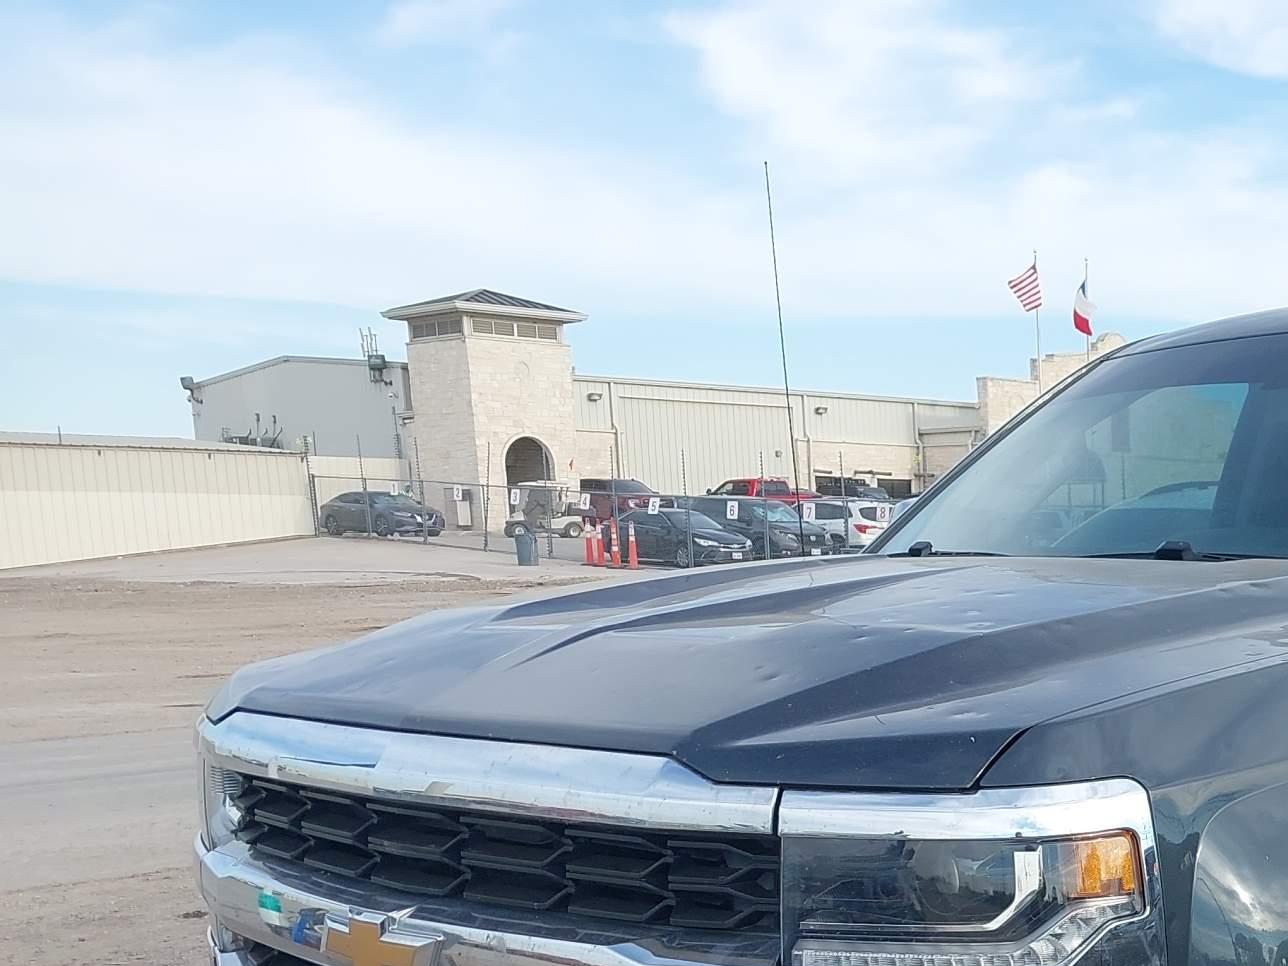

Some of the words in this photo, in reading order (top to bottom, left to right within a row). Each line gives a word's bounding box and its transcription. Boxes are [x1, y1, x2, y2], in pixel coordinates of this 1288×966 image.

[455, 487, 460, 498] 2
[512, 491, 518, 502] 3
[581, 496, 587, 506] 4
[651, 501, 657, 512] 5
[729, 505, 735, 516] 6
[806, 506, 812, 519] 7
[880, 506, 886, 519] 8
